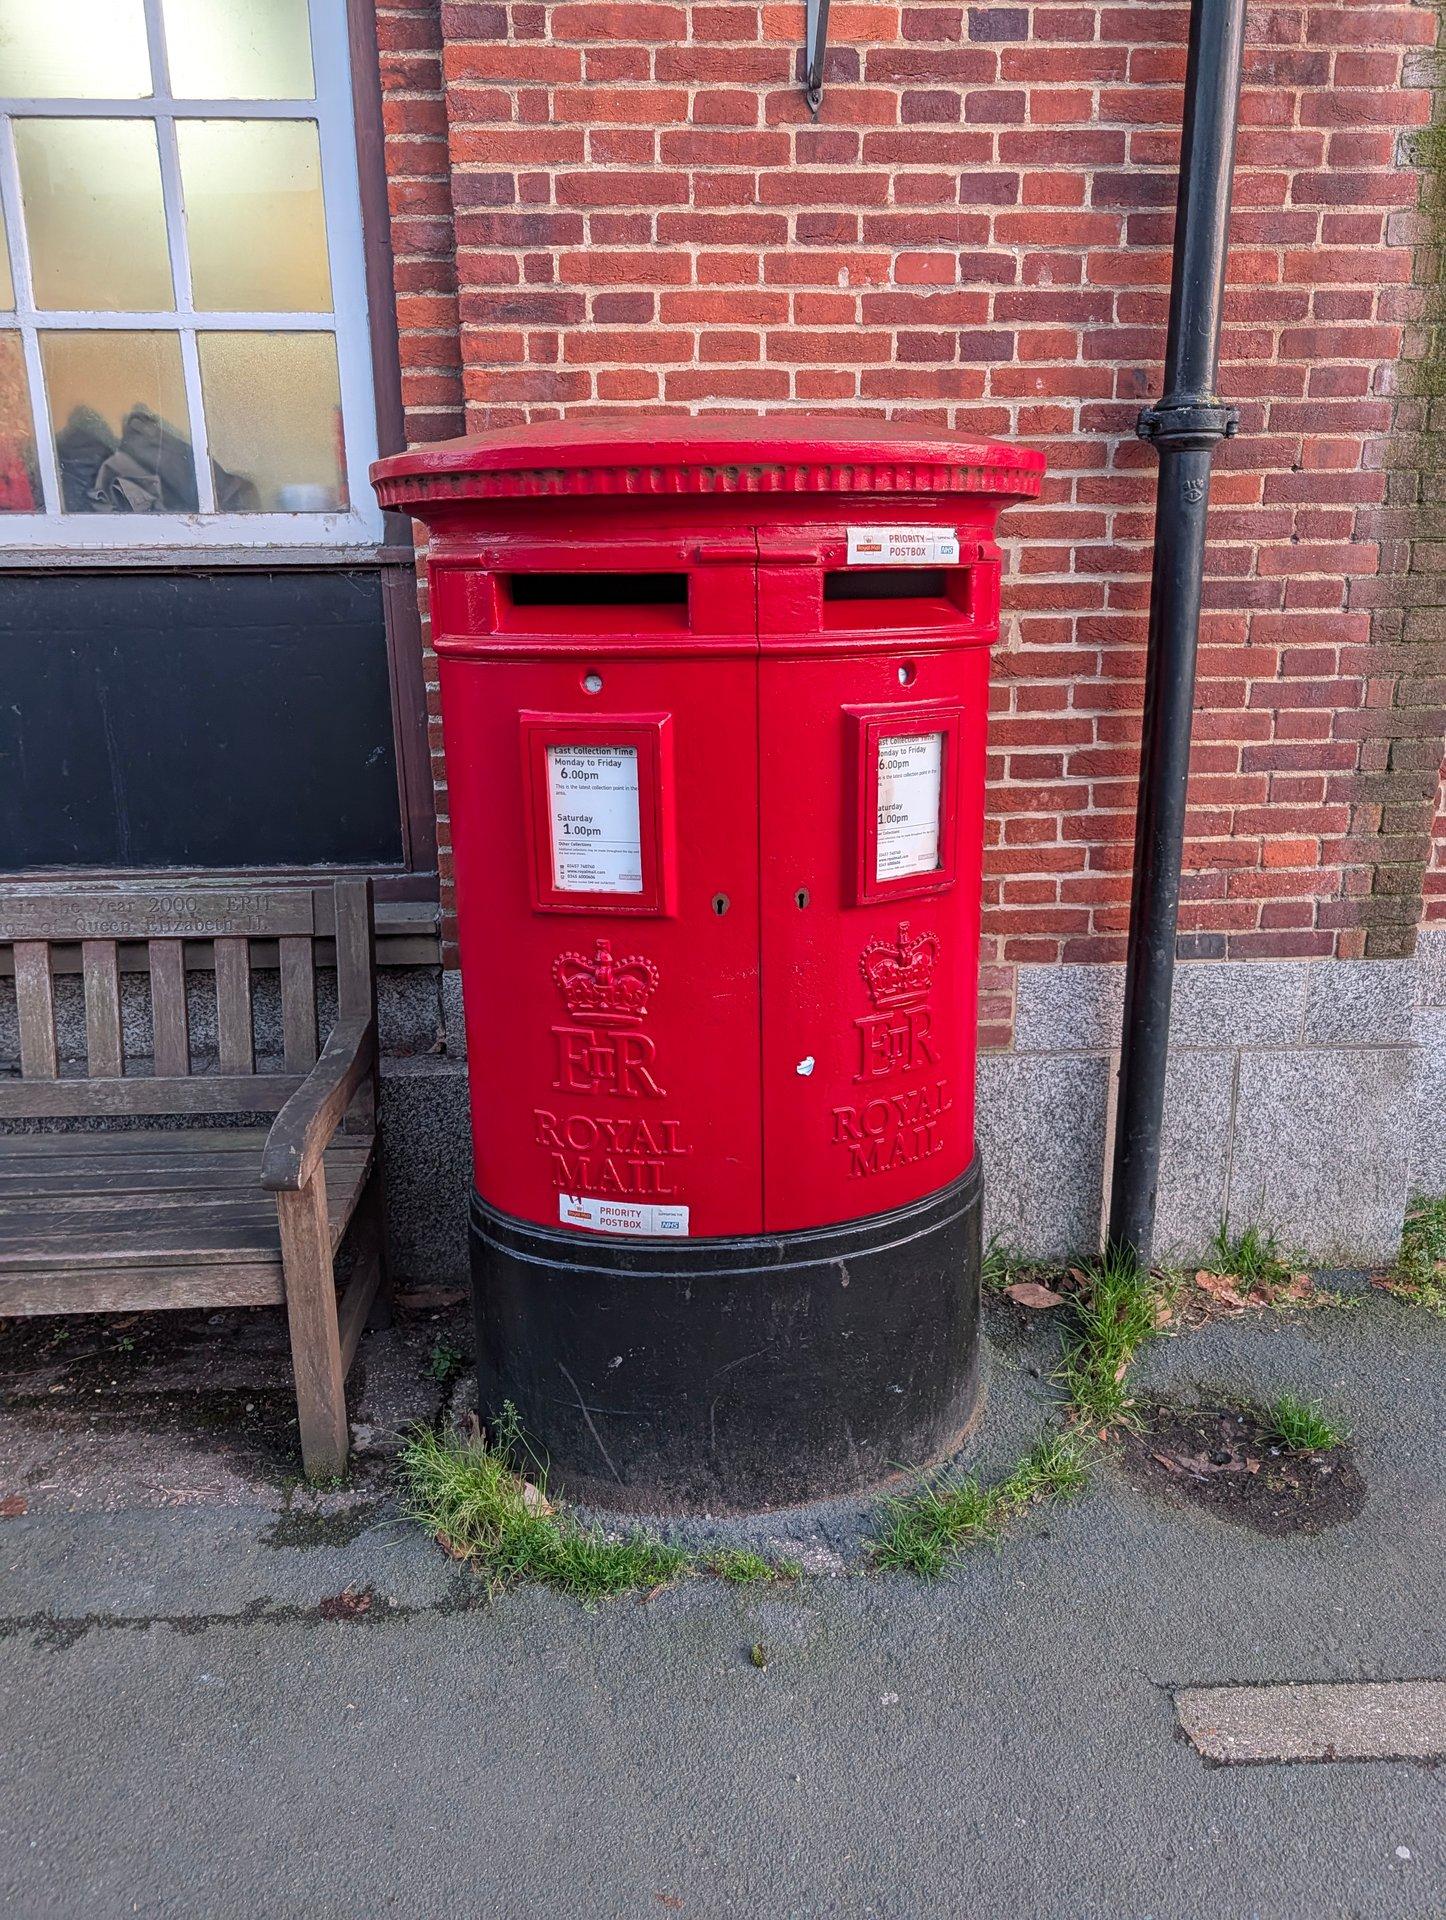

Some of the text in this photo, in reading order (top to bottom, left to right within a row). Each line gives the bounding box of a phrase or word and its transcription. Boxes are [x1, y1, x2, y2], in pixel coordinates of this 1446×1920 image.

[889, 534, 925, 543] PRIORITY
[890, 547, 926, 556] POSTBOX
[878, 738, 888, 746] ast
[554, 747, 634, 756] Last Collection Time
[879, 748, 898, 757] onday
[908, 746, 926, 754] Friday
[554, 758, 584, 767] Monday
[598, 759, 622, 768] Friday
[879, 759, 910, 770] 6.00pm
[560, 768, 599, 781] 6.00pm
[878, 803, 904, 812] aturday
[557, 814, 594, 824] Saturday
[878, 813, 908, 824] 1.00pm
[563, 824, 602, 836] 1.00pm
[75, 918, 131, 933] Queen
[146, 914, 233, 933] Elizabeth
[832, 1080, 952, 1144] ROYAL
[534, 1108, 694, 1155] ROYAL
[848, 1121, 943, 1178] MAIL
[552, 1152, 677, 1194] MAIL
[600, 1206, 642, 1218] PRIORITY
[600, 1218, 642, 1228] POSTBOX
